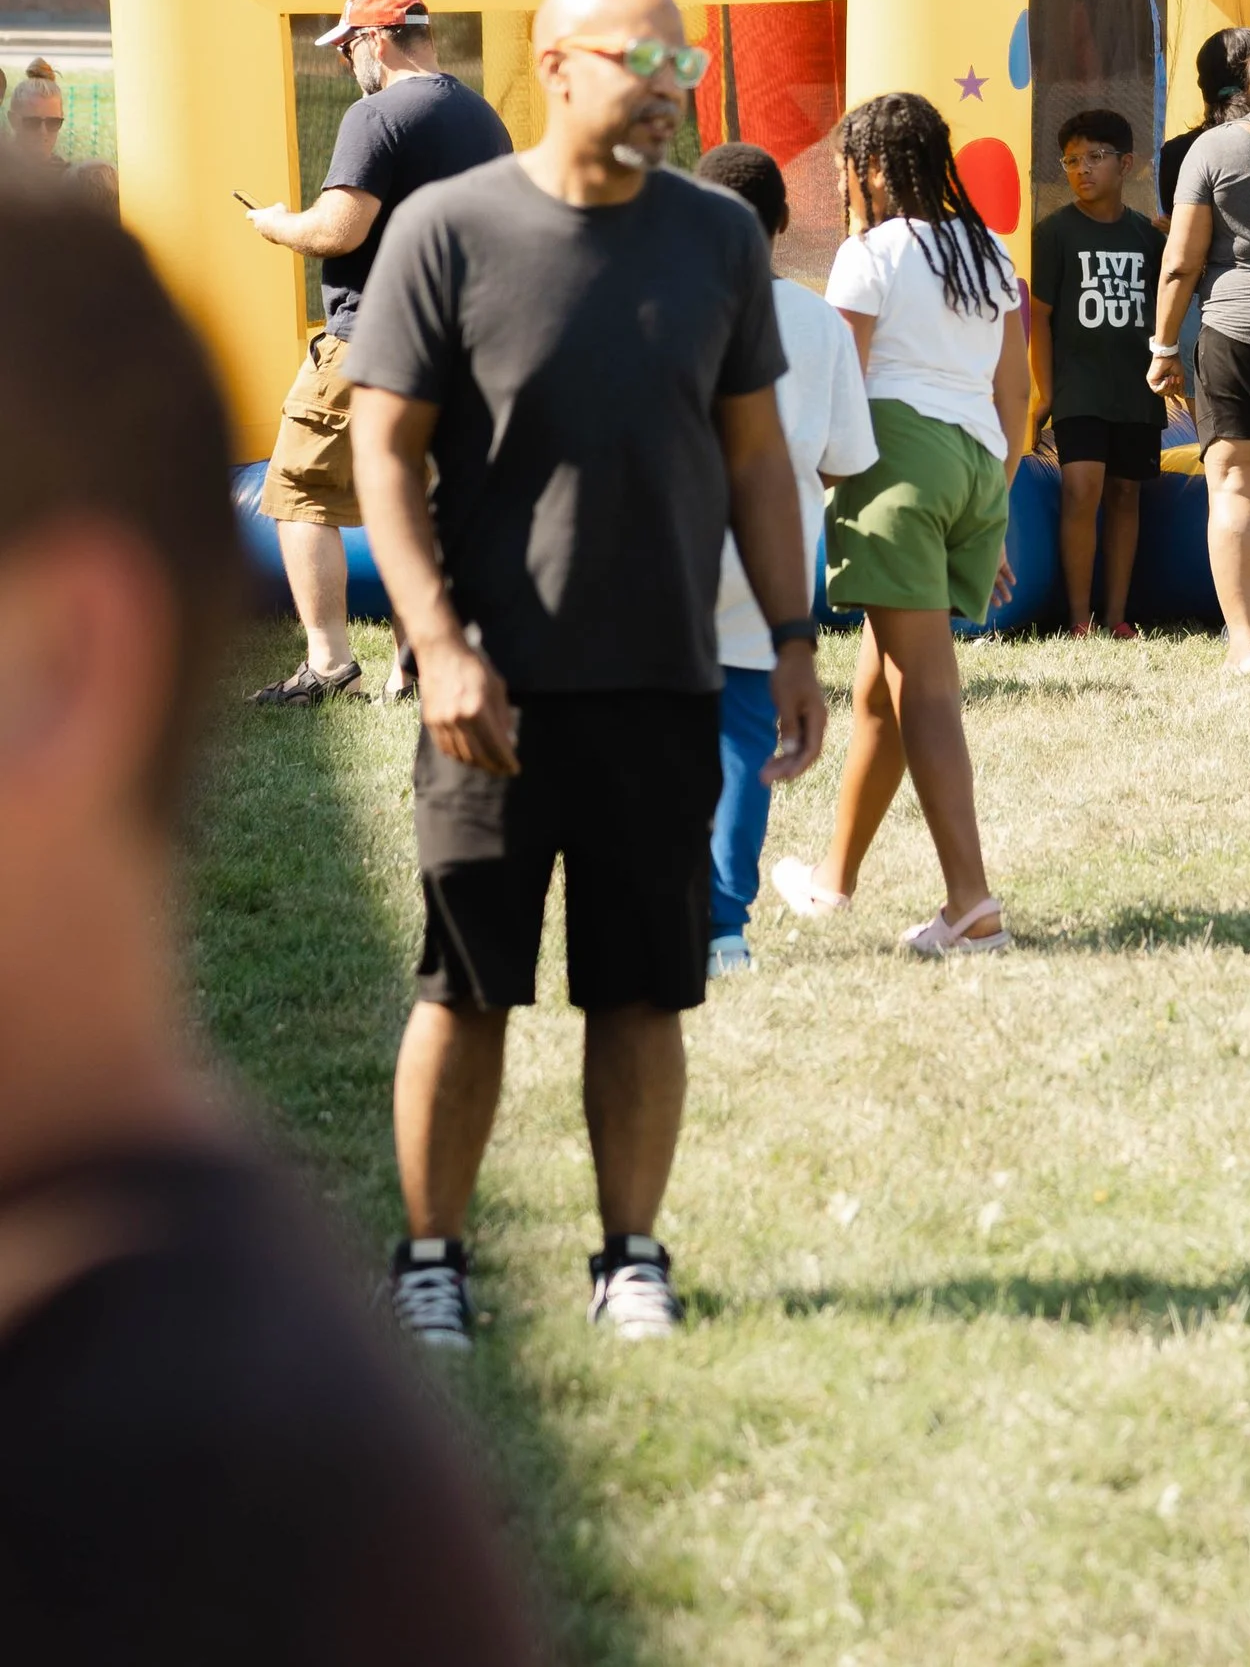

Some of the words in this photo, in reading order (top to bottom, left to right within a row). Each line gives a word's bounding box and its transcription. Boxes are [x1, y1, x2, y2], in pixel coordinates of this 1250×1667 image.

[1078, 251, 1145, 289] LIVE
[1102, 277, 1129, 297] IT
[1078, 289, 1146, 329] OUT
